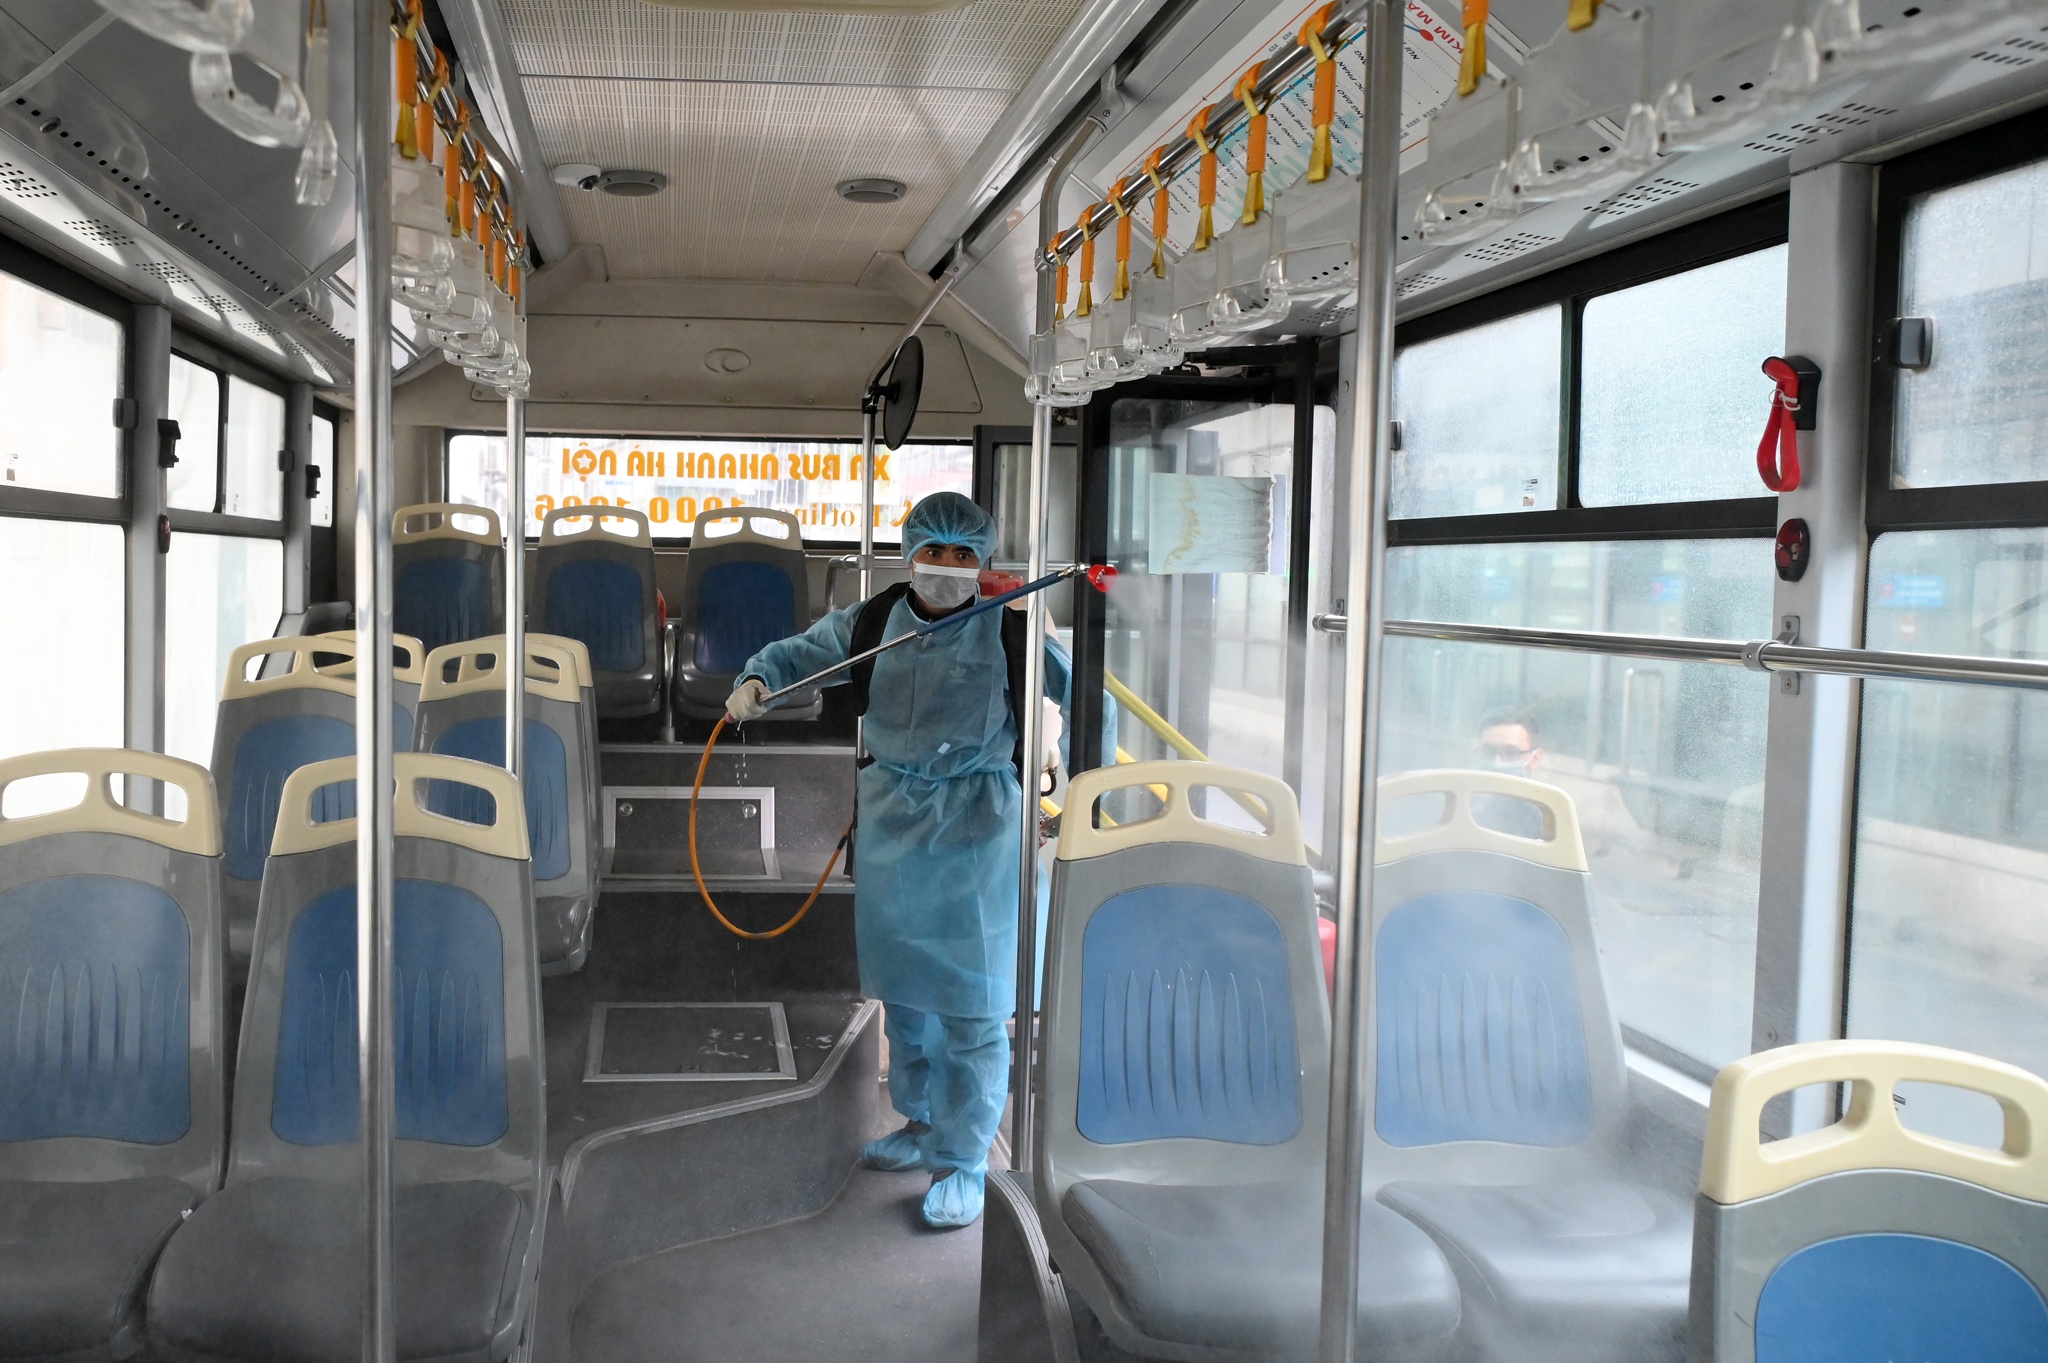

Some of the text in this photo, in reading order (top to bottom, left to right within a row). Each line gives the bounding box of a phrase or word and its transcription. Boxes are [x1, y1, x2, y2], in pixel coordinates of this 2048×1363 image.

[1433, 25, 1463, 53] KIM
[1337, 60, 1357, 81] PHAN
[1280, 102, 1294, 117] VINH
[1282, 128, 1302, 148] TRUNG
